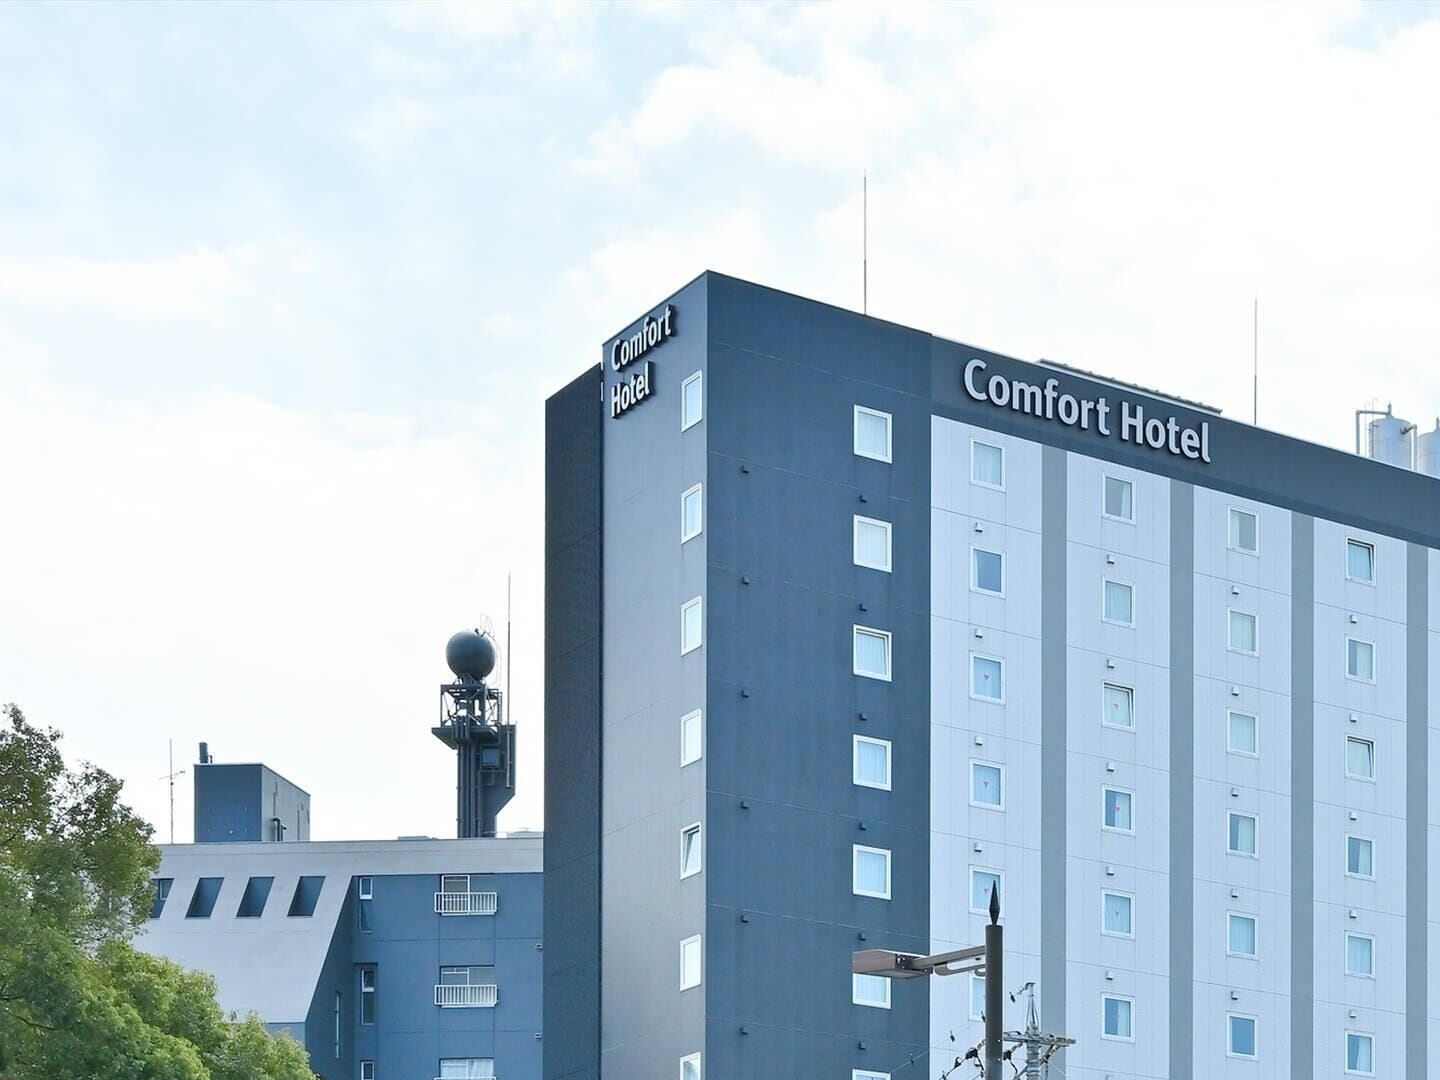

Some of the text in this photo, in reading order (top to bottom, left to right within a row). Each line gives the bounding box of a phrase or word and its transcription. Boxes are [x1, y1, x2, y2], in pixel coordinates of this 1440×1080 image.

[609, 304, 673, 373] Comfort
[609, 361, 653, 419] Hotel
[963, 358, 1212, 465] Comfort Hotel
